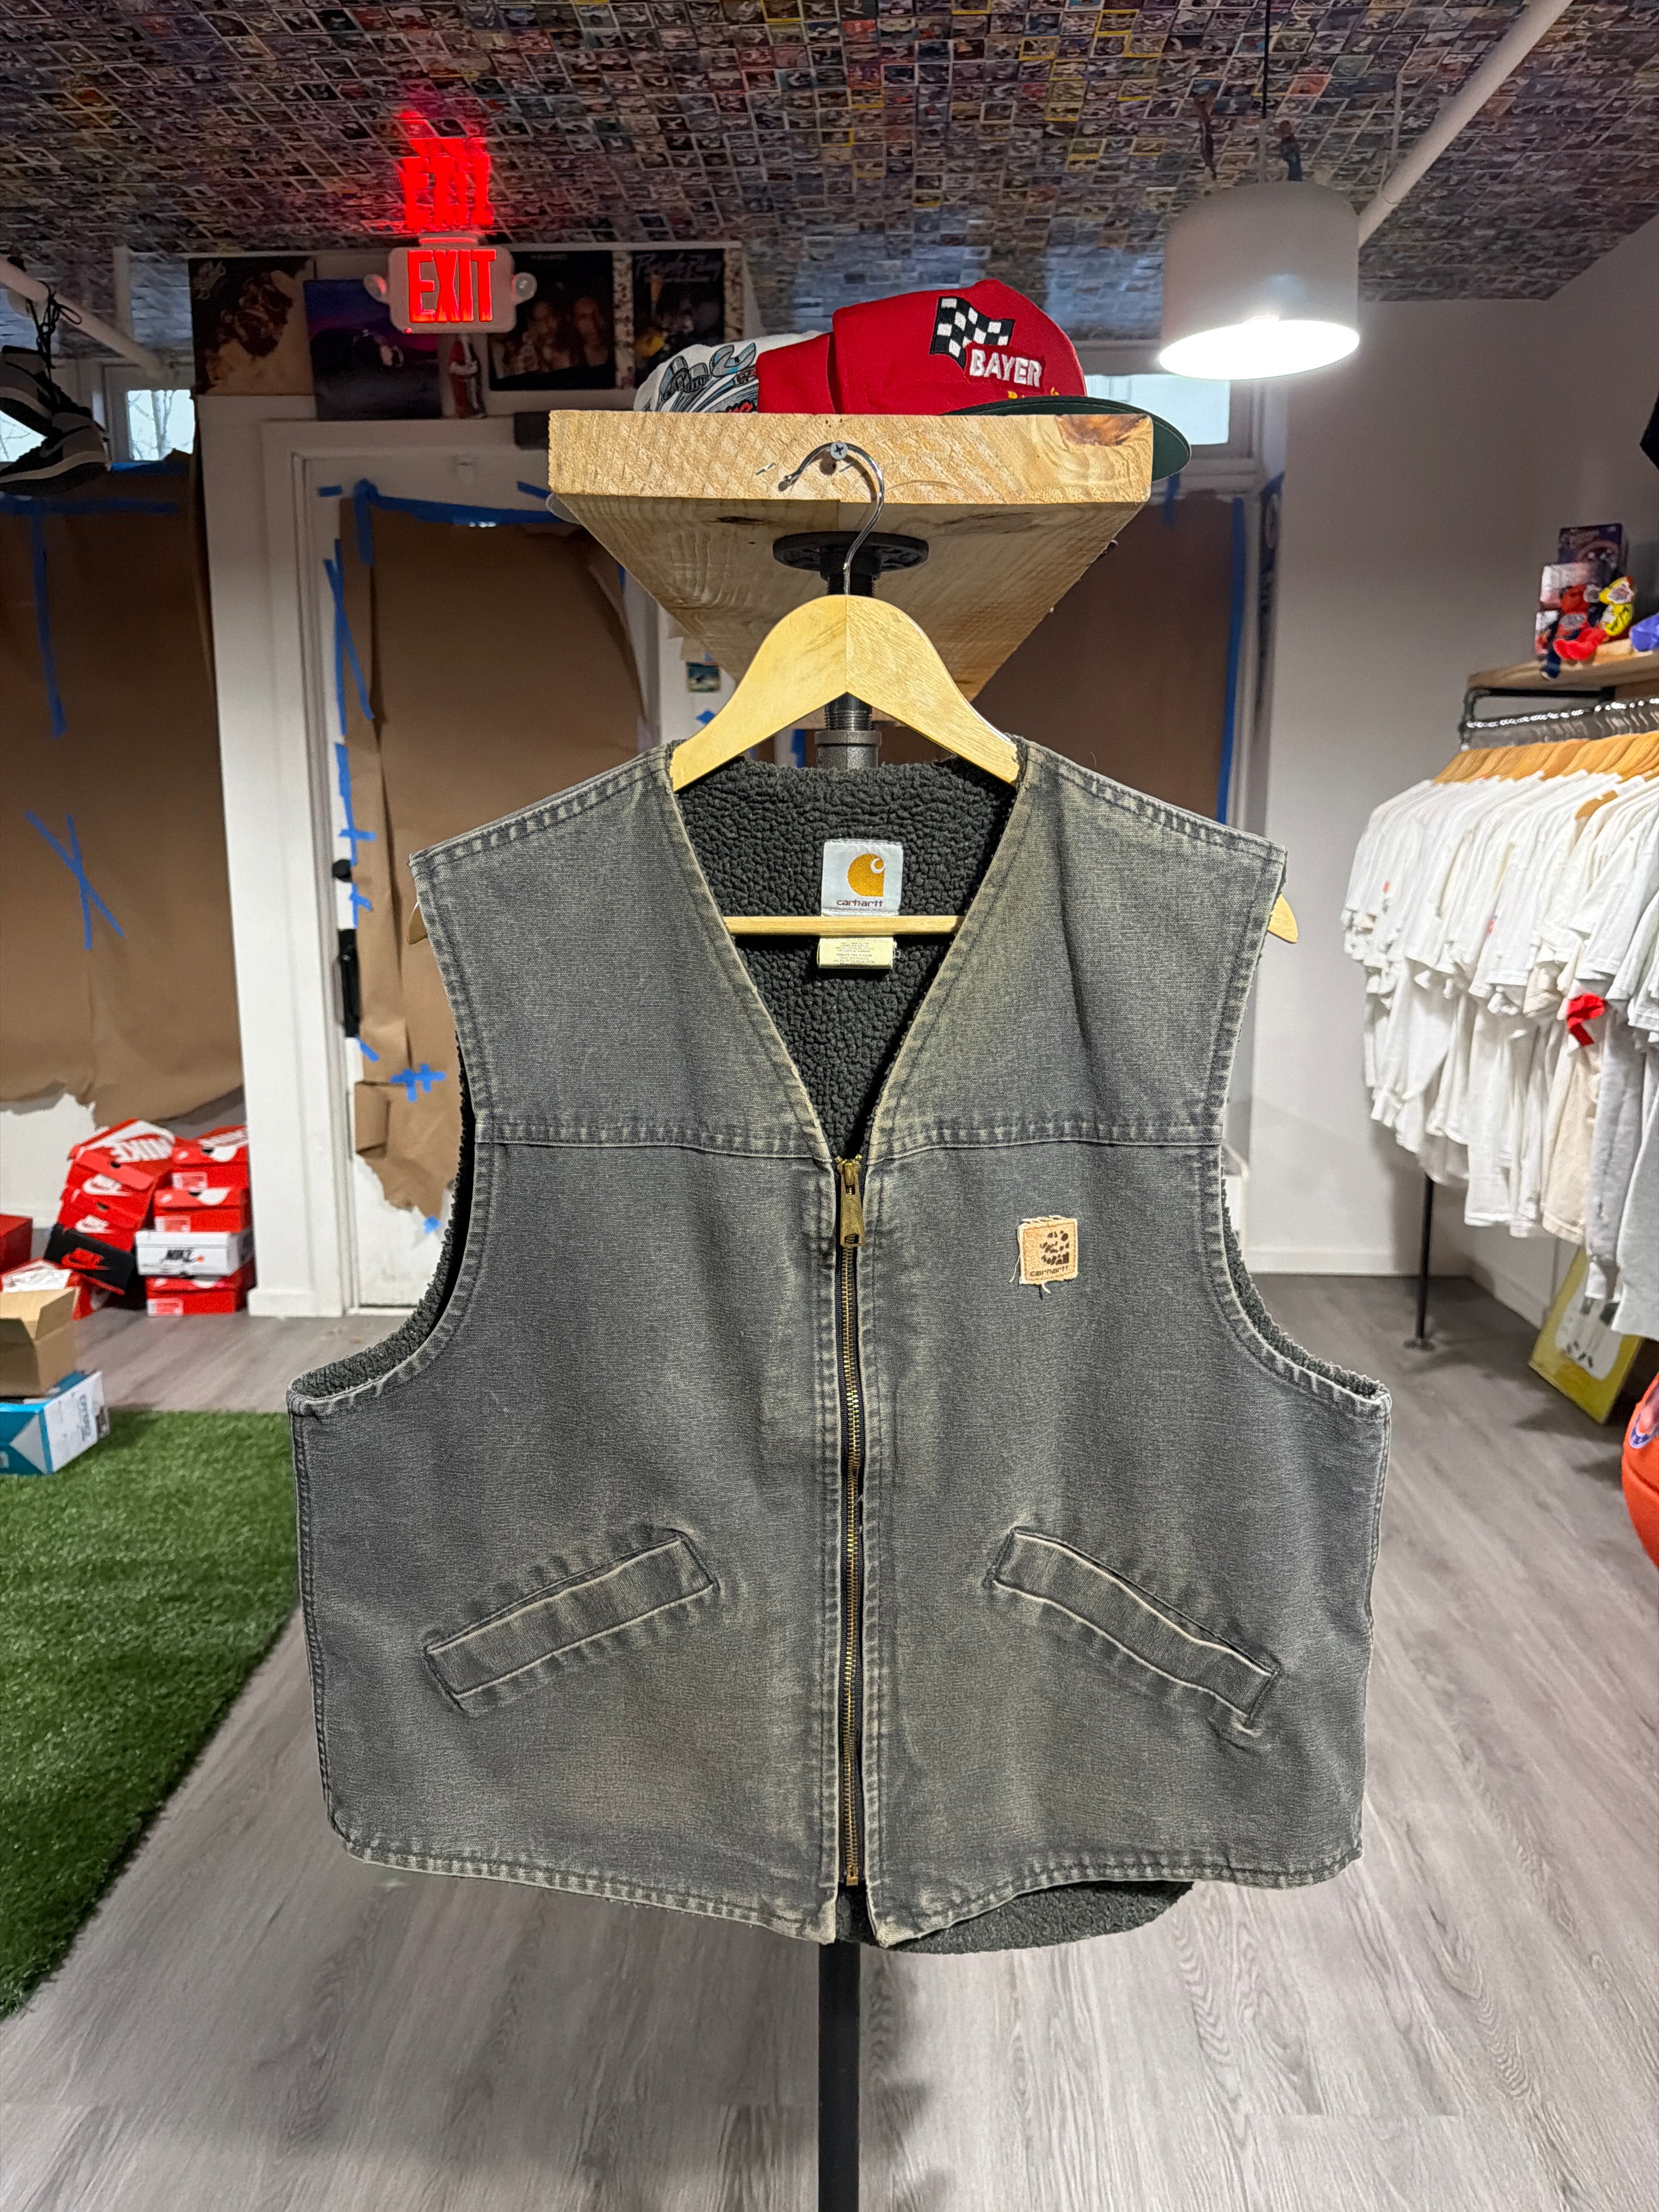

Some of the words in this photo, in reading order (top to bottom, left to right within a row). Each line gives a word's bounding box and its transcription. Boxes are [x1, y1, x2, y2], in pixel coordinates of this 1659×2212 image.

[408, 249, 496, 323] EXIT
[970, 349, 1042, 388] BAYER
[836, 899, 884, 907] carhartt
[1029, 1266, 1069, 1277] carhartt
